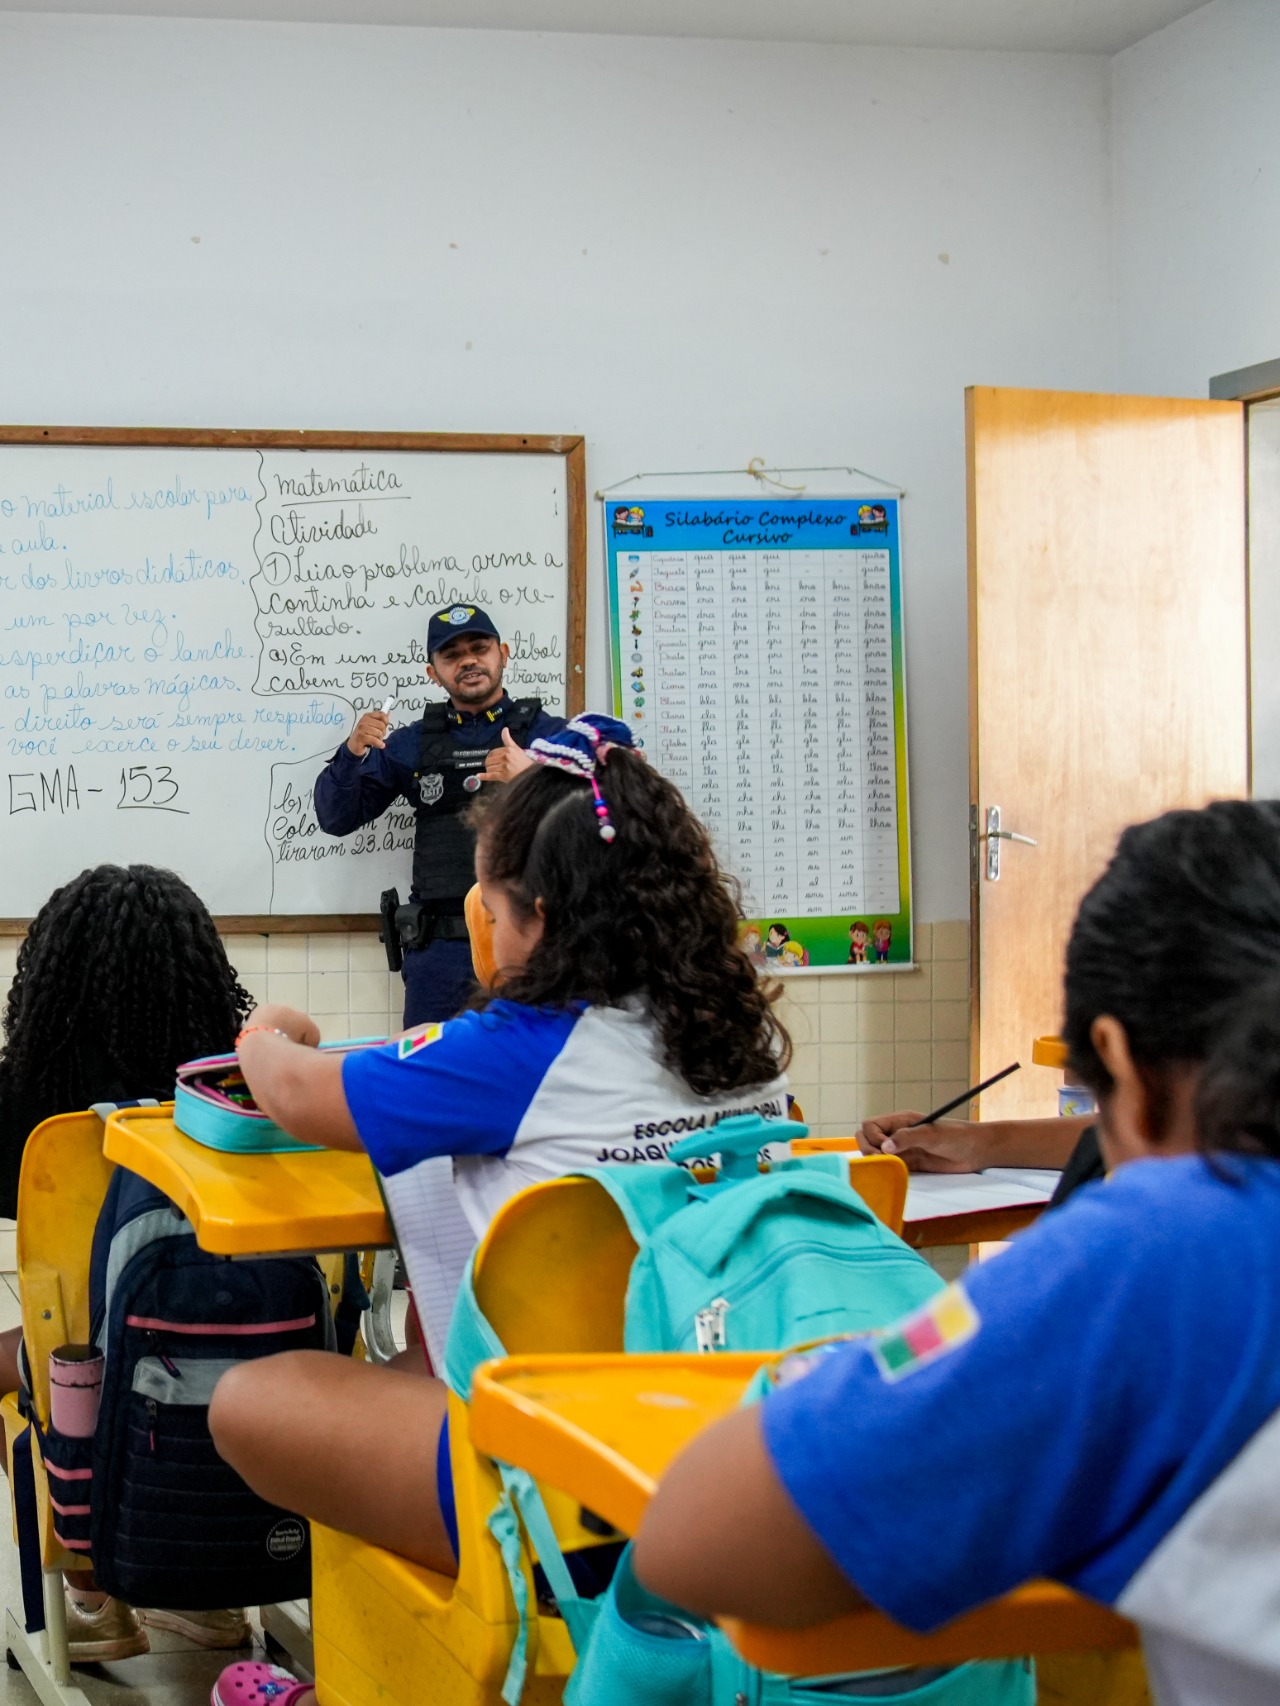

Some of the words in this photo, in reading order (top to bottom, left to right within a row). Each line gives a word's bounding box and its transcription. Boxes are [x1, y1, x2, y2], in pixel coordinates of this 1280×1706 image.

[270, 502, 378, 545] Atividade
[665, 511, 754, 527] Silabário
[759, 510, 847, 529] Complexo
[723, 529, 793, 545] Cursivo
[294, 546, 341, 583] Leia
[342, 565, 358, 578] o
[360, 543, 470, 592] problema,
[472, 551, 537, 573] arme
[544, 552, 563, 568] a
[382, 595, 401, 609] e
[500, 587, 514, 602] o
[262, 615, 361, 638] sultado.
[144, 647, 163, 662] o
[170, 628, 254, 662] lanche.
[269, 648, 287, 665] a)
[290, 642, 325, 666] Em
[335, 652, 376, 665] um
[263, 667, 344, 693] cabem
[351, 671, 389, 688] 550
[14, 703, 97, 732] direito
[98, 711, 164, 731] será
[168, 711, 246, 736] sempre
[8, 764, 79, 815] GMA
[117, 766, 179, 808] 153
[276, 839, 346, 864] tiraram
[351, 834, 381, 855] 23.
[634, 1115, 706, 1140] ESCOLA
